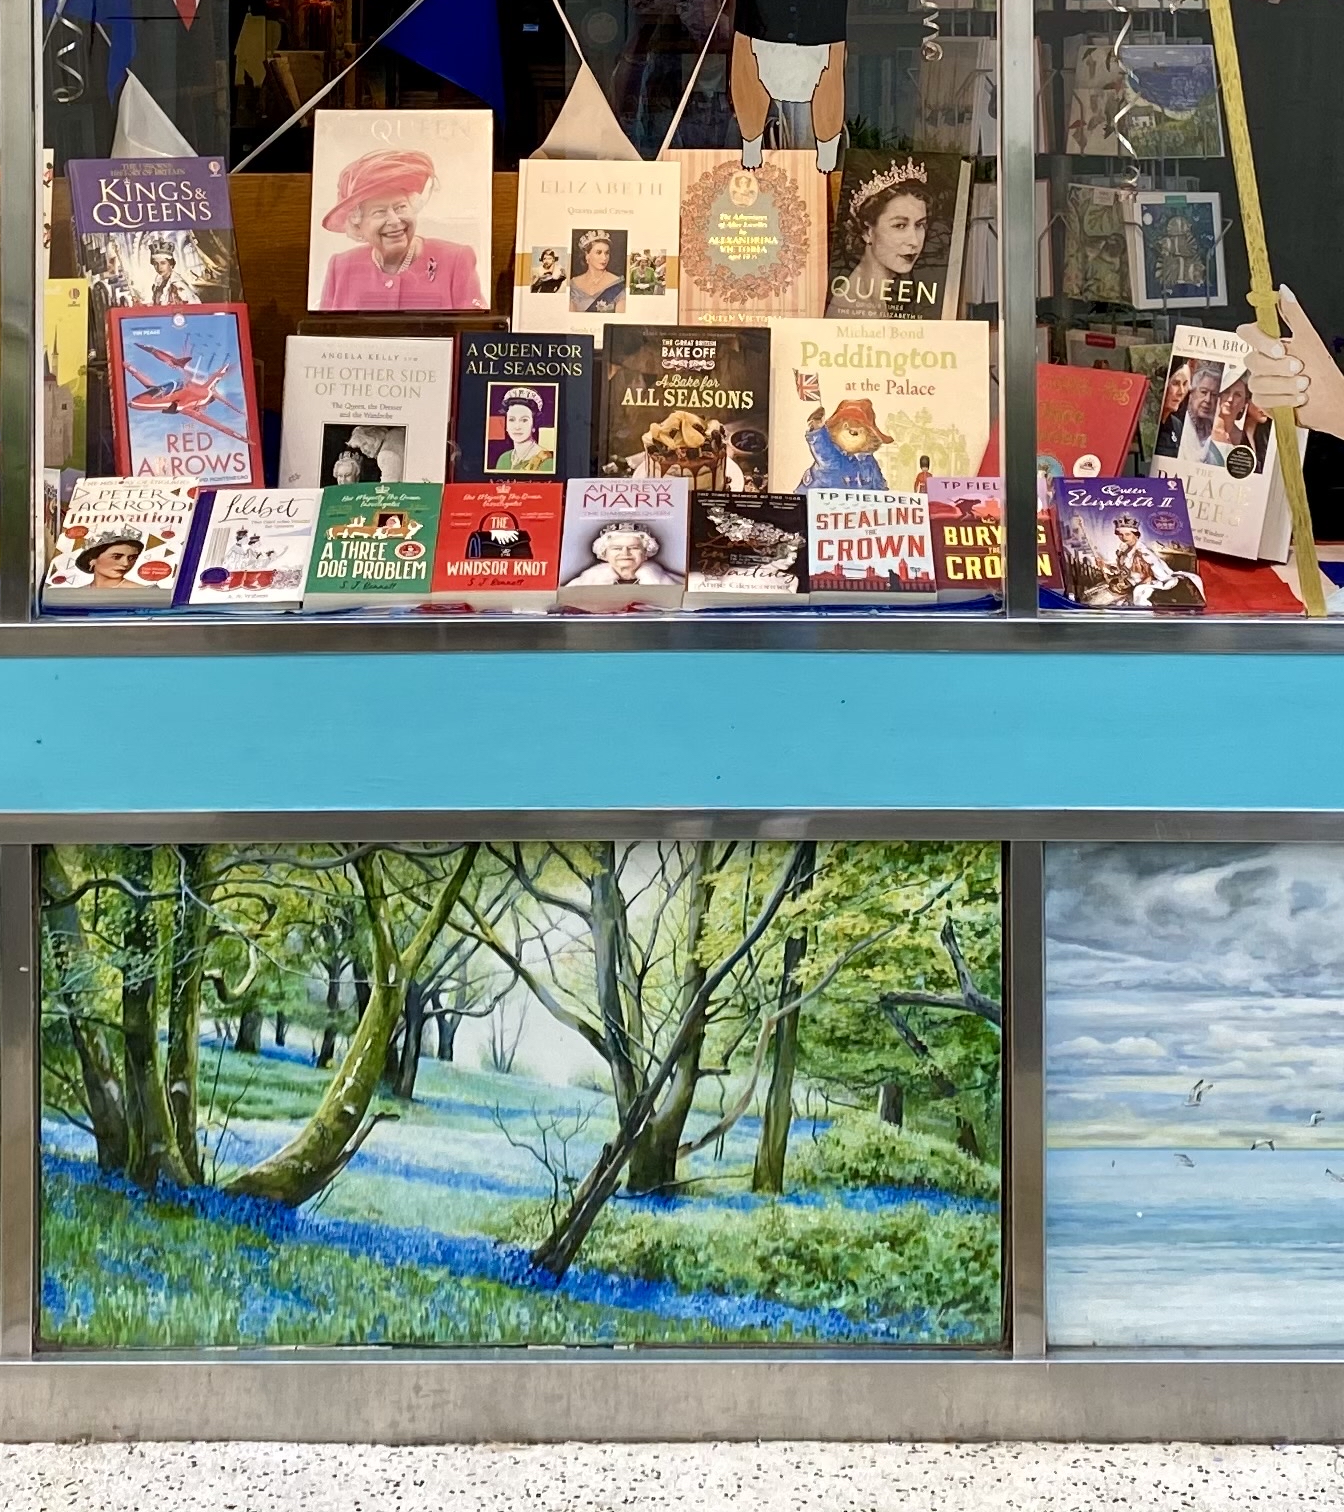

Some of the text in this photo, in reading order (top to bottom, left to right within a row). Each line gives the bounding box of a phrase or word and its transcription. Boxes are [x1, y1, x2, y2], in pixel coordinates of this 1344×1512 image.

[98, 177, 207, 202] KINGS &
[540, 180, 663, 196] ELIZABETH
[92, 201, 212, 229] QUEENS
[567, 206, 593, 215] Queen
[594, 207, 607, 215] and
[708, 236, 778, 245] ALEXANDRINA
[831, 275, 937, 305] QUEEN
[837, 326, 924, 339] Michael Bond
[466, 342, 582, 360] A QUEEN FOR
[1188, 334, 1217, 350] TINA
[1222, 338, 1251, 354] BRO
[321, 352, 362, 360] ANGELA
[662, 347, 716, 358] BAKE OFF
[800, 341, 958, 377] Paddington
[304, 366, 437, 383] THE OTHER SIDE
[466, 360, 583, 376] ALL SEASONS
[655, 374, 721, 391] A Bake for
[845, 378, 936, 396] at the Palace
[315, 383, 422, 399] OF THE COIN
[621, 387, 754, 410] ALL SEASONS
[167, 432, 213, 453] RED
[1195, 467, 1213, 478] THE
[584, 484, 673, 493] ANDREW
[942, 481, 961, 490] TP
[1101, 485, 1147, 496] Queen
[98, 489, 168, 501] PETER
[582, 493, 675, 508] MARR
[817, 492, 921, 505] TP FIELDEN
[1068, 489, 1175, 511] Elizabeth II
[78, 500, 187, 512] ACKROYD
[217, 494, 300, 524] Lilibet
[69, 513, 183, 525] Innovation
[491, 516, 509, 529] THE
[816, 507, 924, 530] STEALING
[943, 525, 1047, 547] BURYG
[321, 541, 387, 561] A THREE
[817, 535, 926, 561] CROWN
[316, 560, 427, 580] DOG PROBLEM
[446, 561, 549, 576] WINDSOR KNOT
[945, 554, 1052, 580] CRON
